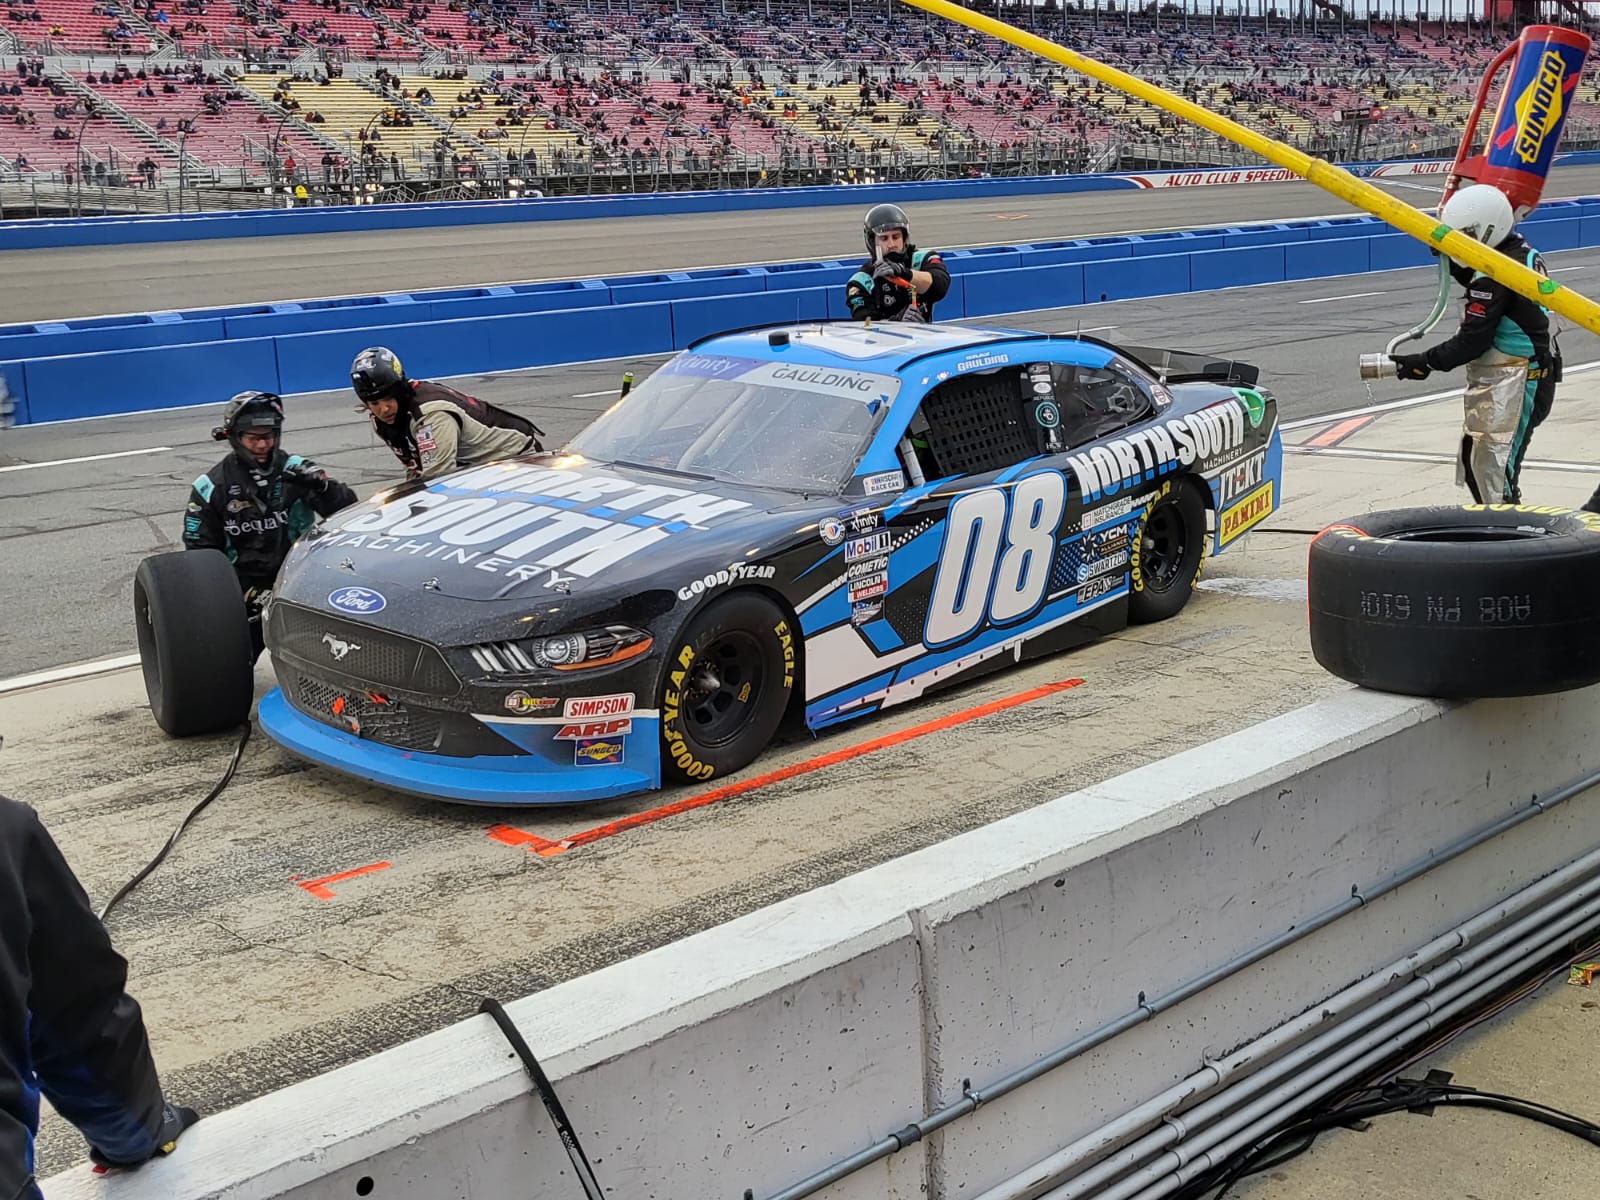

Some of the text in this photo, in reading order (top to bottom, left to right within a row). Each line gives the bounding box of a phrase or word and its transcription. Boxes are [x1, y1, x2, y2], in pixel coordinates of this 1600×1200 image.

[1519, 53, 1564, 158] SUNOCO
[1410, 162, 1440, 173] AUTO
[1164, 173, 1203, 186] AUTO
[1206, 172, 1241, 184] CLUB
[674, 355, 739, 376] xfinity
[957, 354, 1009, 371] GAULDING
[772, 368, 875, 392] GAULDING
[1067, 400, 1244, 505] NORTH SOUTH
[1203, 447, 1244, 472] MACHINERY
[871, 482, 887, 491] RACE
[1217, 450, 1267, 513] JTEKT
[425, 464, 753, 533] NORTH
[851, 514, 878, 532] xfinity
[1095, 507, 1125, 524] INSURANCE
[1223, 489, 1270, 537] PANINI
[340, 491, 672, 578] SOUTH
[1100, 524, 1127, 542] YCM
[846, 535, 877, 558] Mobil
[1101, 538, 1127, 551] ALLIANCE
[307, 530, 577, 589] MACHINERY
[849, 556, 888, 577] COMETIC
[923, 471, 1066, 646] 08
[1089, 550, 1127, 577] SWARTZCO
[678, 561, 776, 601] GOODYEAR
[850, 575, 881, 592] LINCOLN
[857, 584, 884, 599] WELDERS
[336, 590, 377, 610] Ford
[774, 620, 794, 689] EAGLE
[570, 697, 629, 717] SIMPSON
[663, 645, 715, 780] GOODYEAR
[558, 719, 631, 737] ARP
[579, 745, 621, 755] SUNOCO
